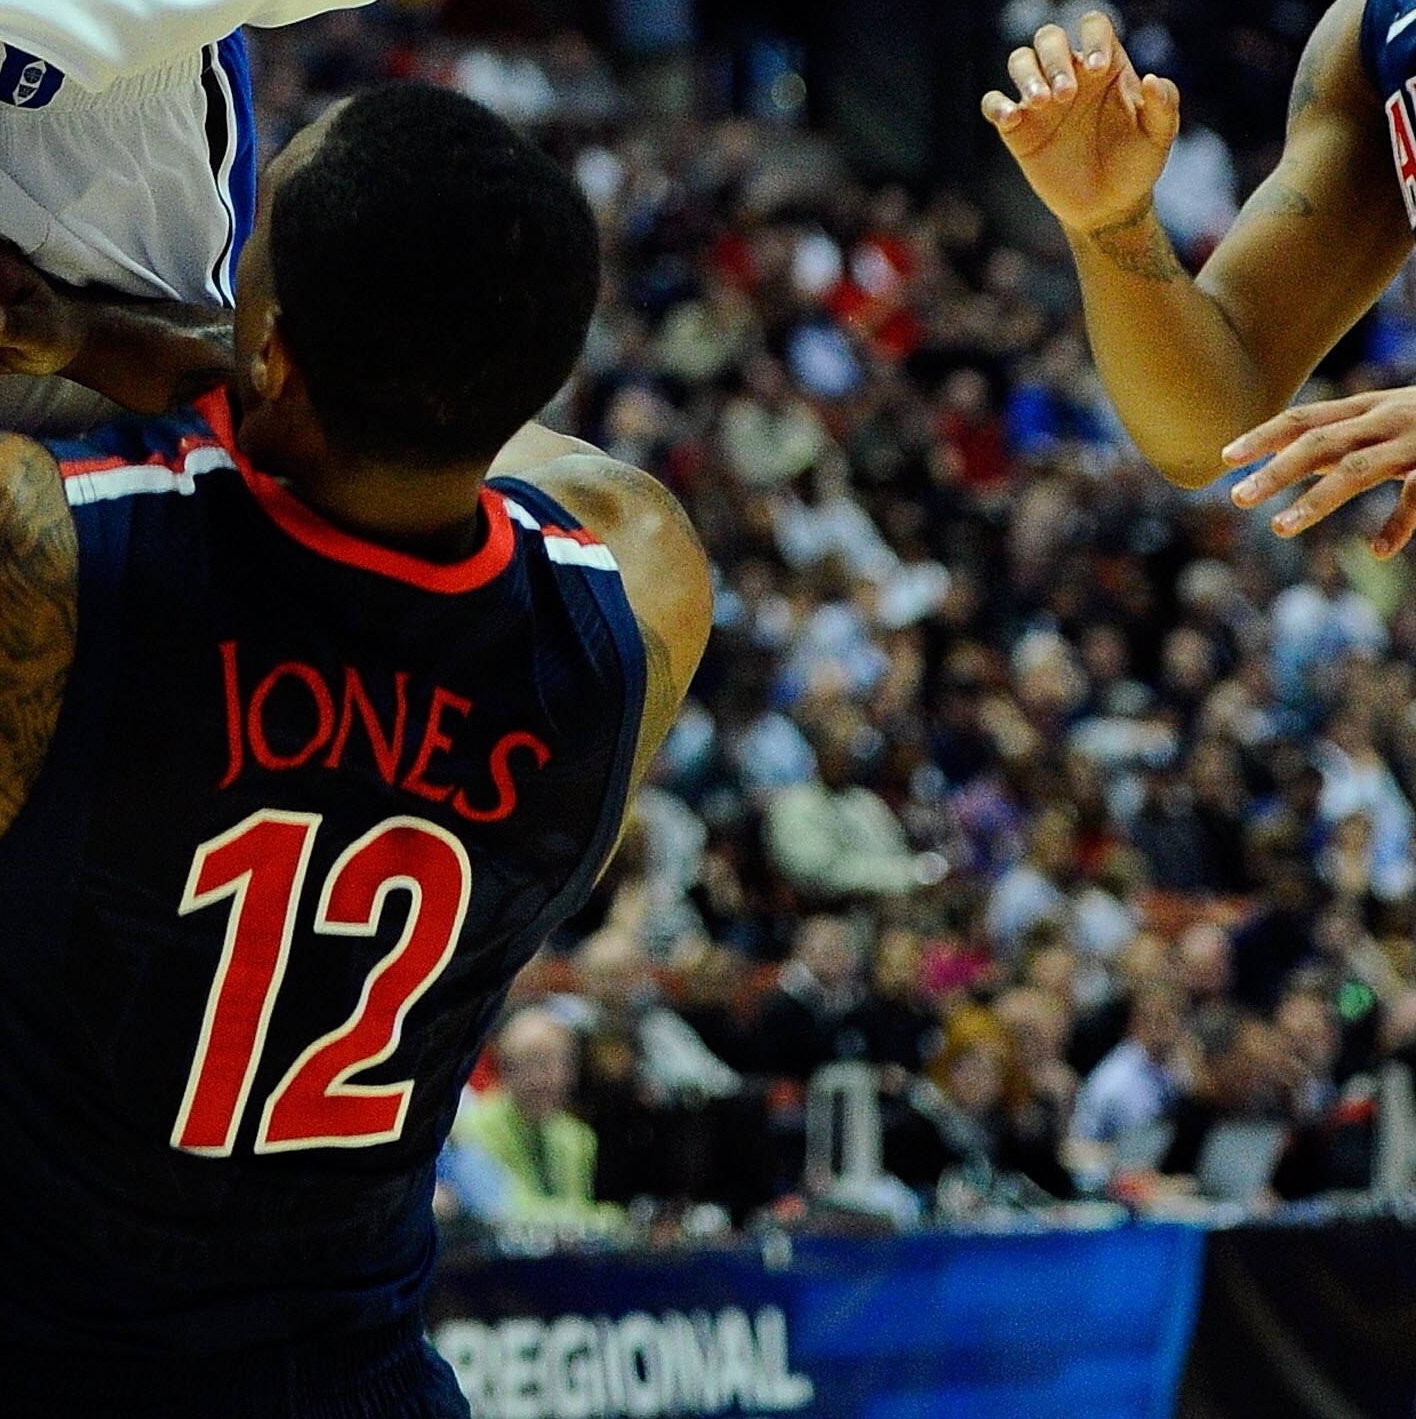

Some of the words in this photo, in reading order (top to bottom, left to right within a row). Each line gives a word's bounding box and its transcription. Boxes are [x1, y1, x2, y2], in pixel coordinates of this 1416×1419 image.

[217, 640, 551, 822] JONES
[170, 808, 471, 1157] 12
[436, 1305, 814, 1419] REGIONAL
